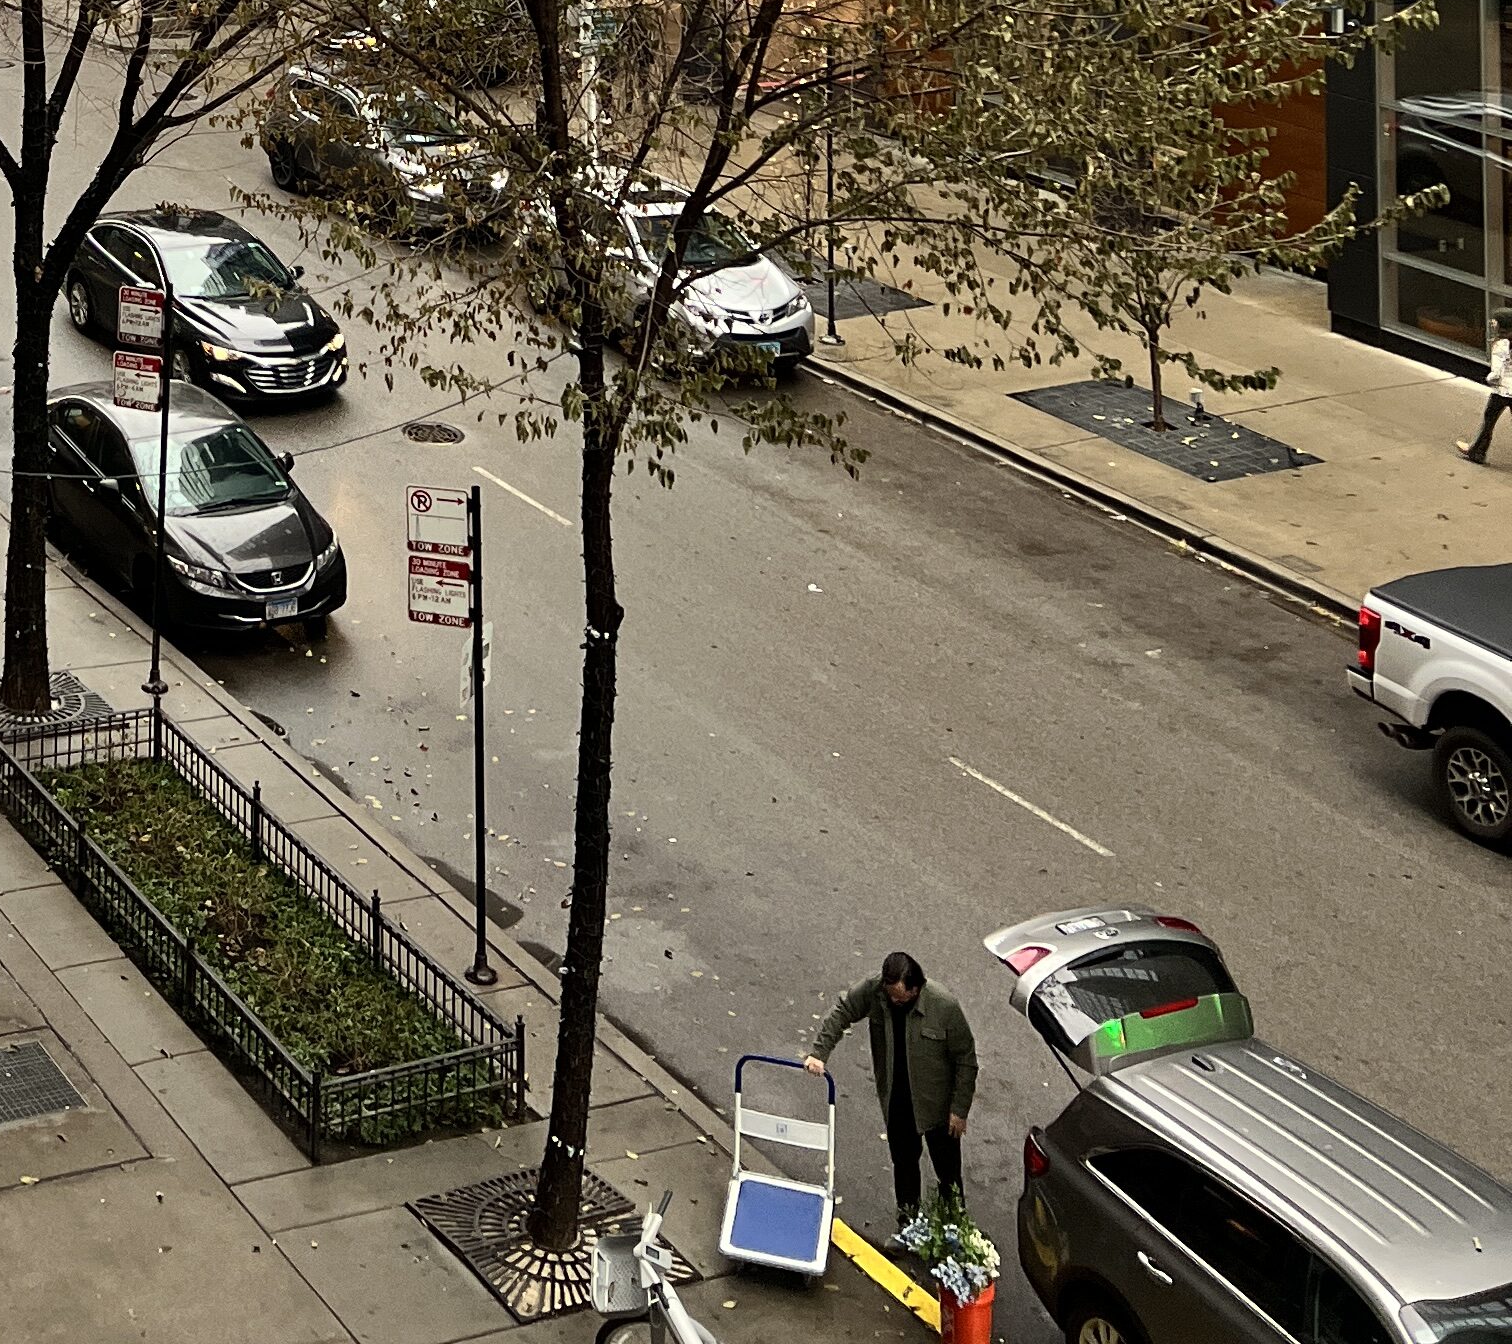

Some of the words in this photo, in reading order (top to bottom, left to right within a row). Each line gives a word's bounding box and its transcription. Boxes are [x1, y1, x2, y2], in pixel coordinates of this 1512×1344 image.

[121, 333, 137, 343] TOW
[140, 336, 159, 346] ZONE
[116, 399, 132, 407] TOW
[135, 401, 156, 411] ZONE
[411, 541, 433, 552] TOW
[438, 544, 464, 555] ZONE
[411, 557, 421, 565] 30
[422, 559, 447, 569] MINUTE
[411, 565, 440, 576] LOADING
[442, 569, 460, 578] ZONE
[412, 612, 434, 622] TOW
[438, 615, 465, 627] ZONE
